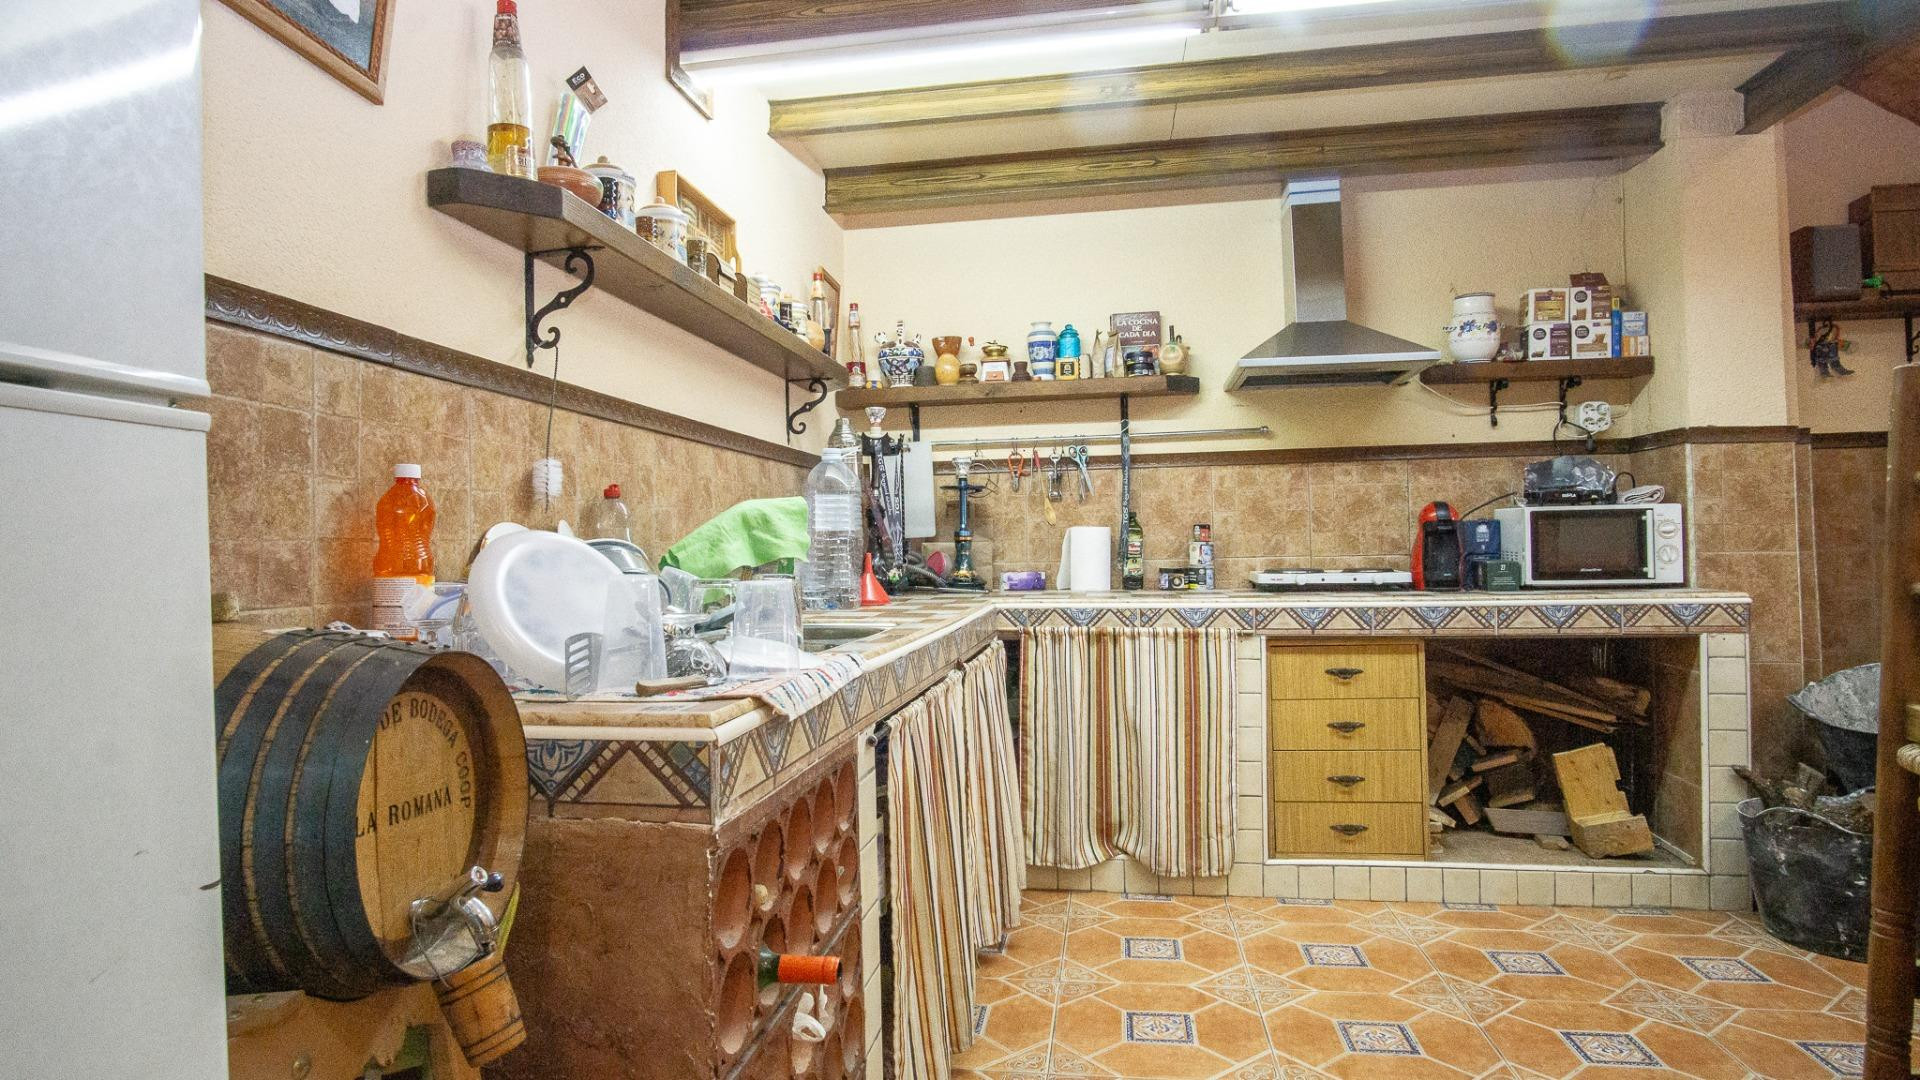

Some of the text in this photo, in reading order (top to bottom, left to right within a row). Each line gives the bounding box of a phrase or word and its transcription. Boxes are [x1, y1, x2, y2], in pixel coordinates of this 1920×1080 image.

[380, 698, 472, 808] DE BODEGA COOP
[355, 786, 452, 838] LA ROMANA
